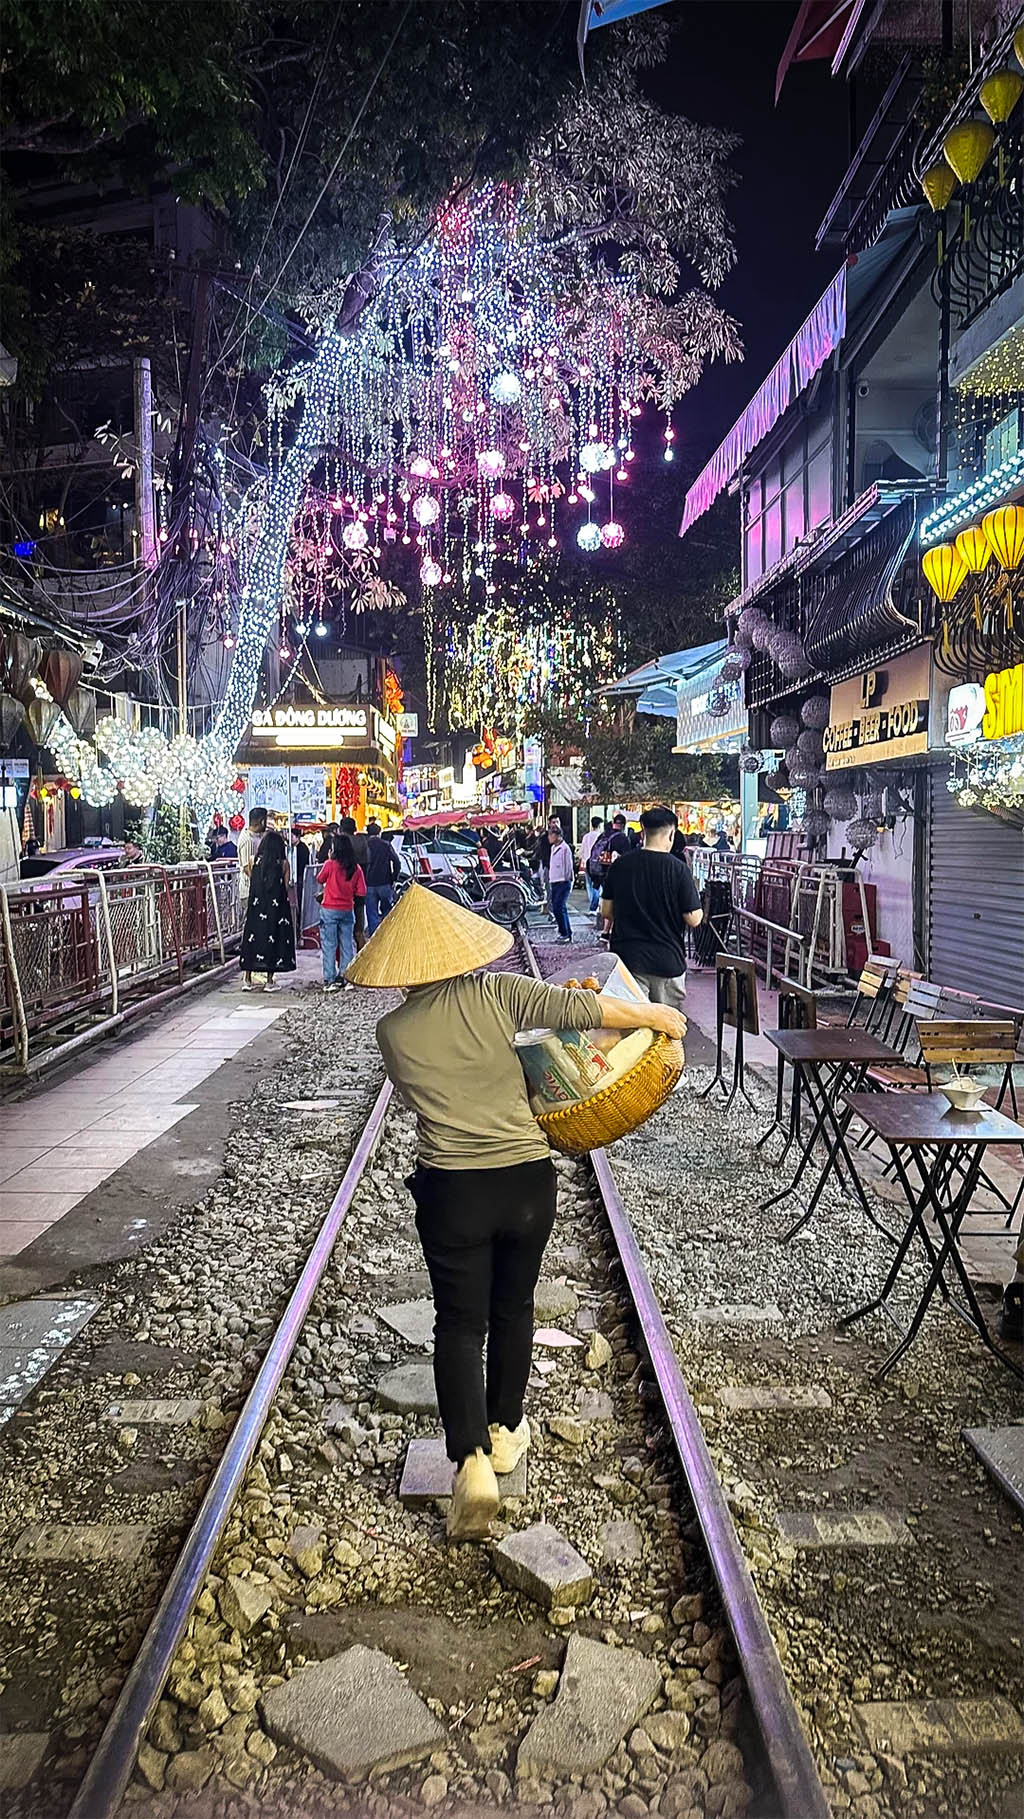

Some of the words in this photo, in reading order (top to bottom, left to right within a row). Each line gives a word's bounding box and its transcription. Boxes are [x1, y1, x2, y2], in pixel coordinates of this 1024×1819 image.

[823, 721, 852, 753] COFFEE
[859, 712, 880, 745] BEER
[888, 700, 918, 738] FOOD
